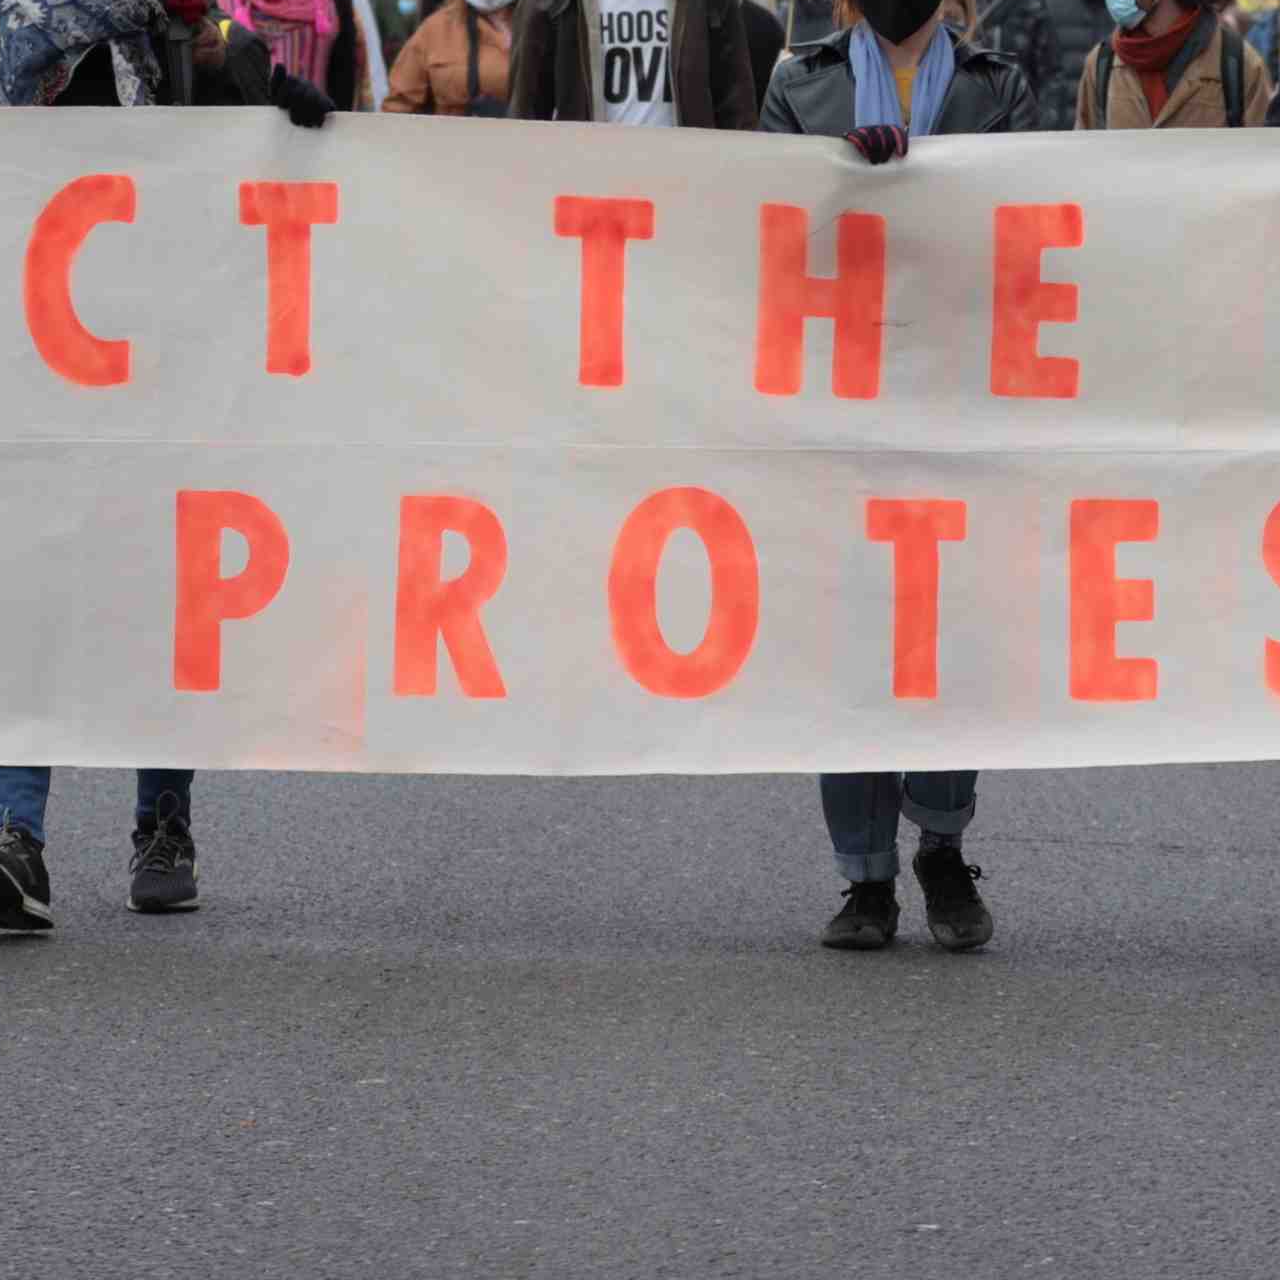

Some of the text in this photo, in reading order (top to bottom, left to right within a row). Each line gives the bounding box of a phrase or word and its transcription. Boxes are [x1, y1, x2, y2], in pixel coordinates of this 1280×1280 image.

[600, 9, 668, 43] HOOS
[604, 46, 672, 104] OV
[553, 195, 1085, 401] THE
